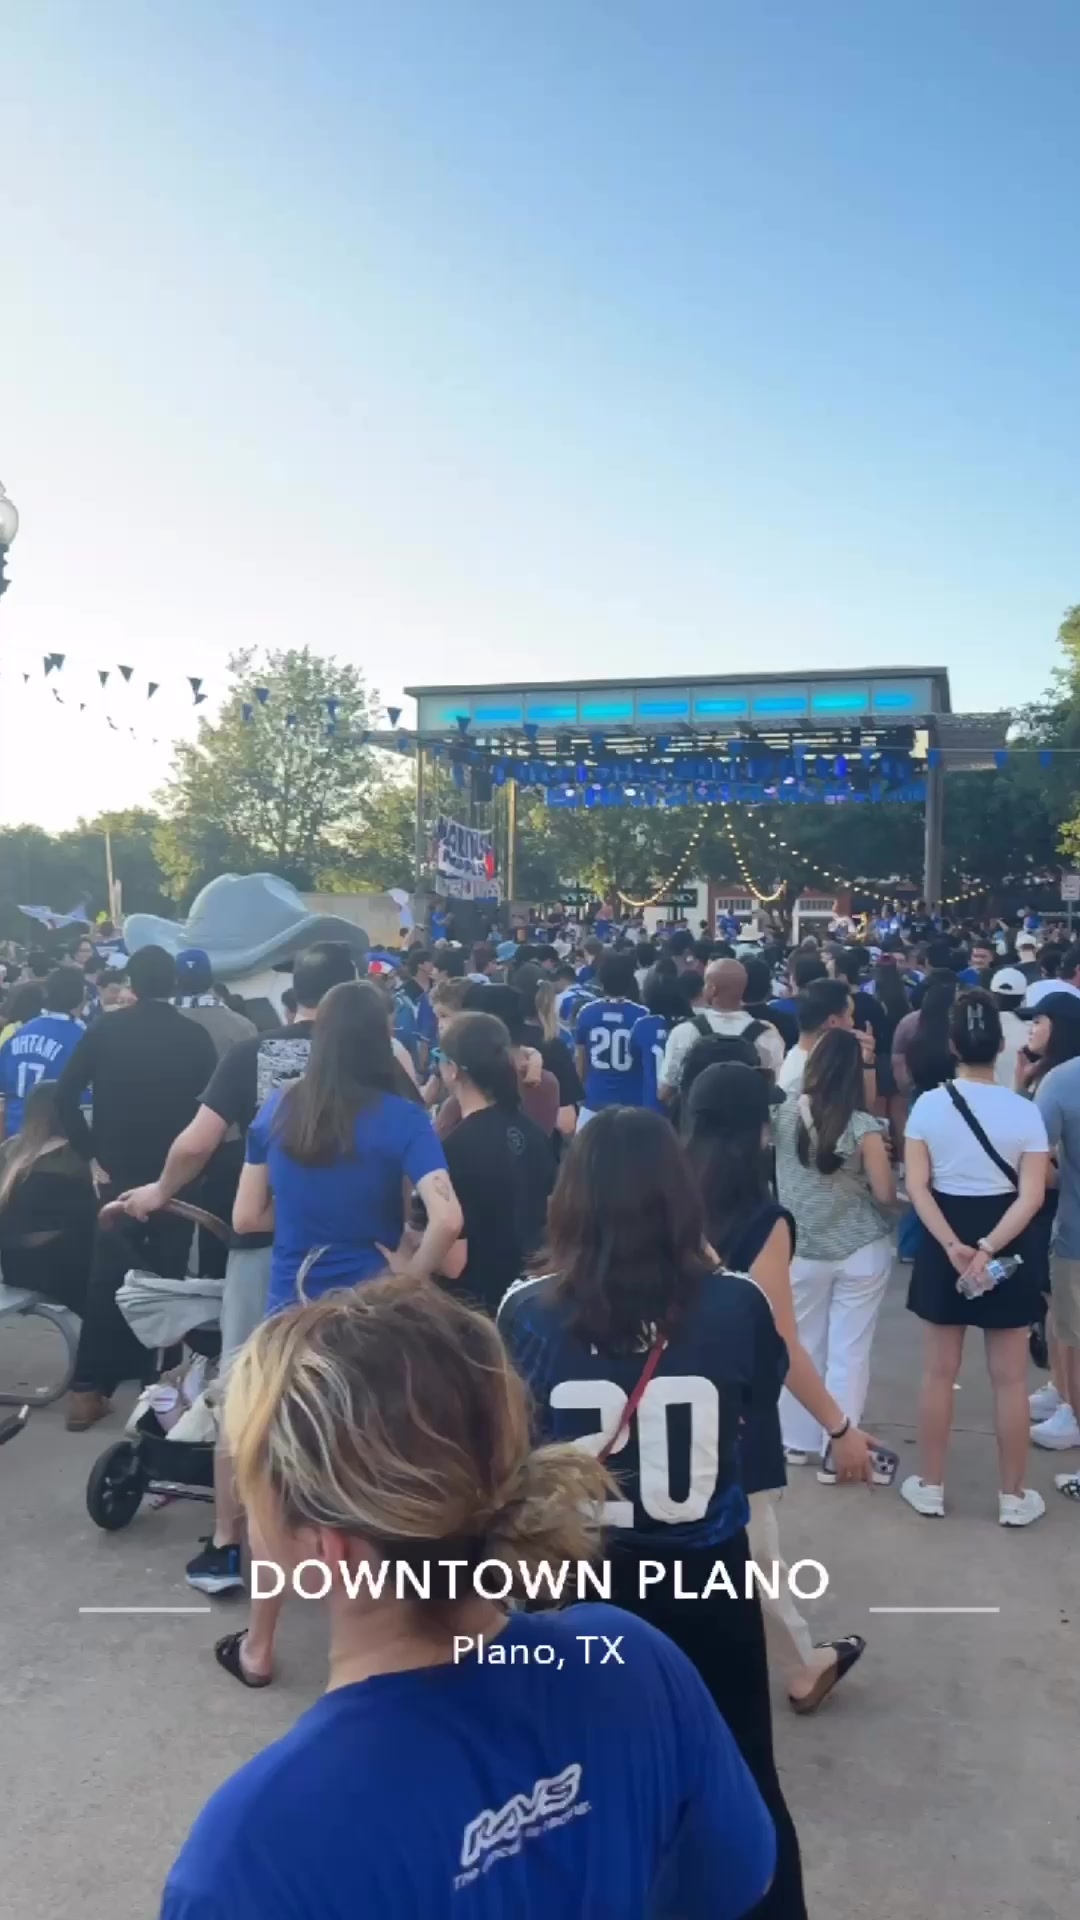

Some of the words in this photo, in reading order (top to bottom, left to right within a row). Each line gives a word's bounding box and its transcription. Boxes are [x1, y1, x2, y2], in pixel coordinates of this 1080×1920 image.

[11, 1034, 63, 1061] OHTANI
[590, 1026, 633, 1072] 20
[549, 1375, 720, 1528] 20
